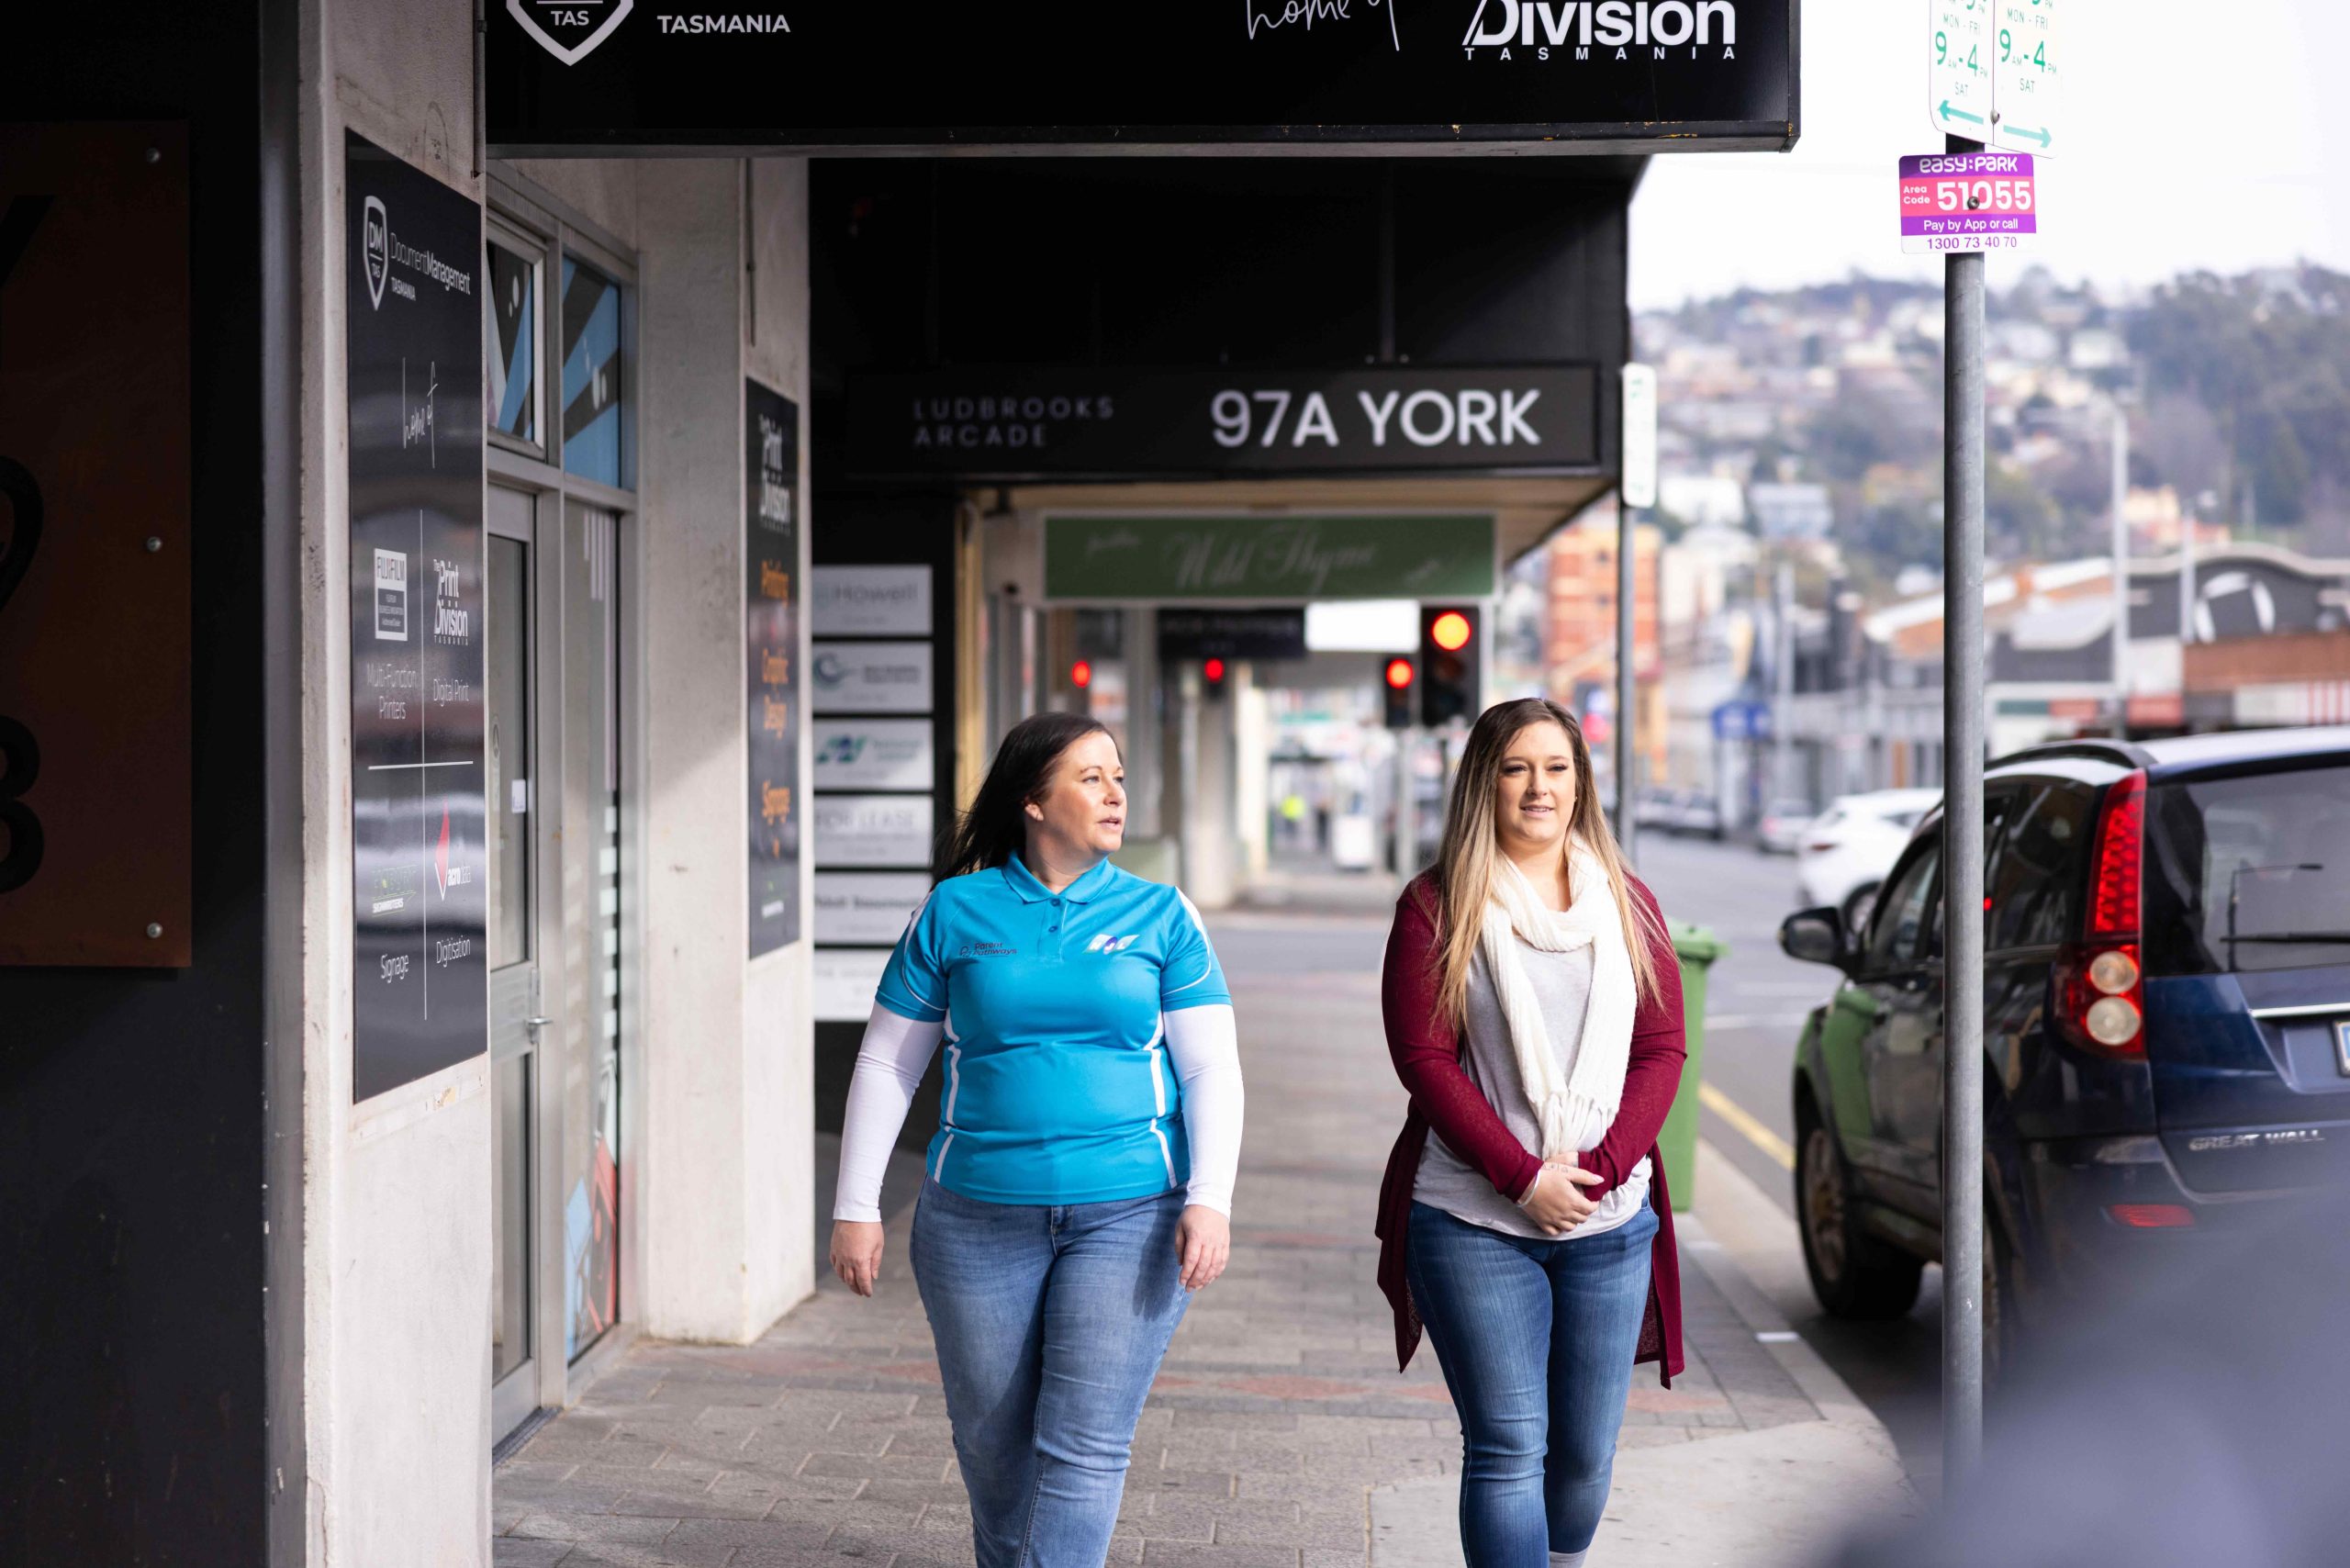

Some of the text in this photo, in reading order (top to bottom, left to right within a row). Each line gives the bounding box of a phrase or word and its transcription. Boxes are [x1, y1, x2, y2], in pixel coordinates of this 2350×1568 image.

[551, 10, 590, 27] TAS
[656, 14, 791, 34] TASMANIA
[1462, 0, 1736, 45] Division
[1942, 13, 1959, 28] MON
[1969, 19, 1981, 36] FRI
[2007, 7, 2025, 24] MON
[2035, 15, 2049, 30] FRI
[1464, 46, 1735, 61] TASMANIA
[1954, 81, 1969, 96] SAT
[2020, 77, 2035, 95] SAT
[1903, 185, 1928, 194] Area
[1903, 196, 1930, 205] Code
[1937, 180, 2031, 211] 51055
[369, 221, 383, 253] DM
[1923, 218, 2019, 233] Pay by App or call
[1927, 236, 2017, 250] 1300 73 40 70
[912, 396, 1114, 421] LUDBROOKS
[1211, 389, 1541, 447] 97A YORK
[914, 423, 1047, 448] ARCADE
[439, 560, 460, 599] Print
[433, 598, 469, 637] Division
[433, 678, 469, 707] Digital Print
[379, 695, 406, 720] Printers
[436, 935, 471, 968] Digitisation
[380, 953, 409, 983] Signage
[2189, 1134, 2260, 1151] GREAT
